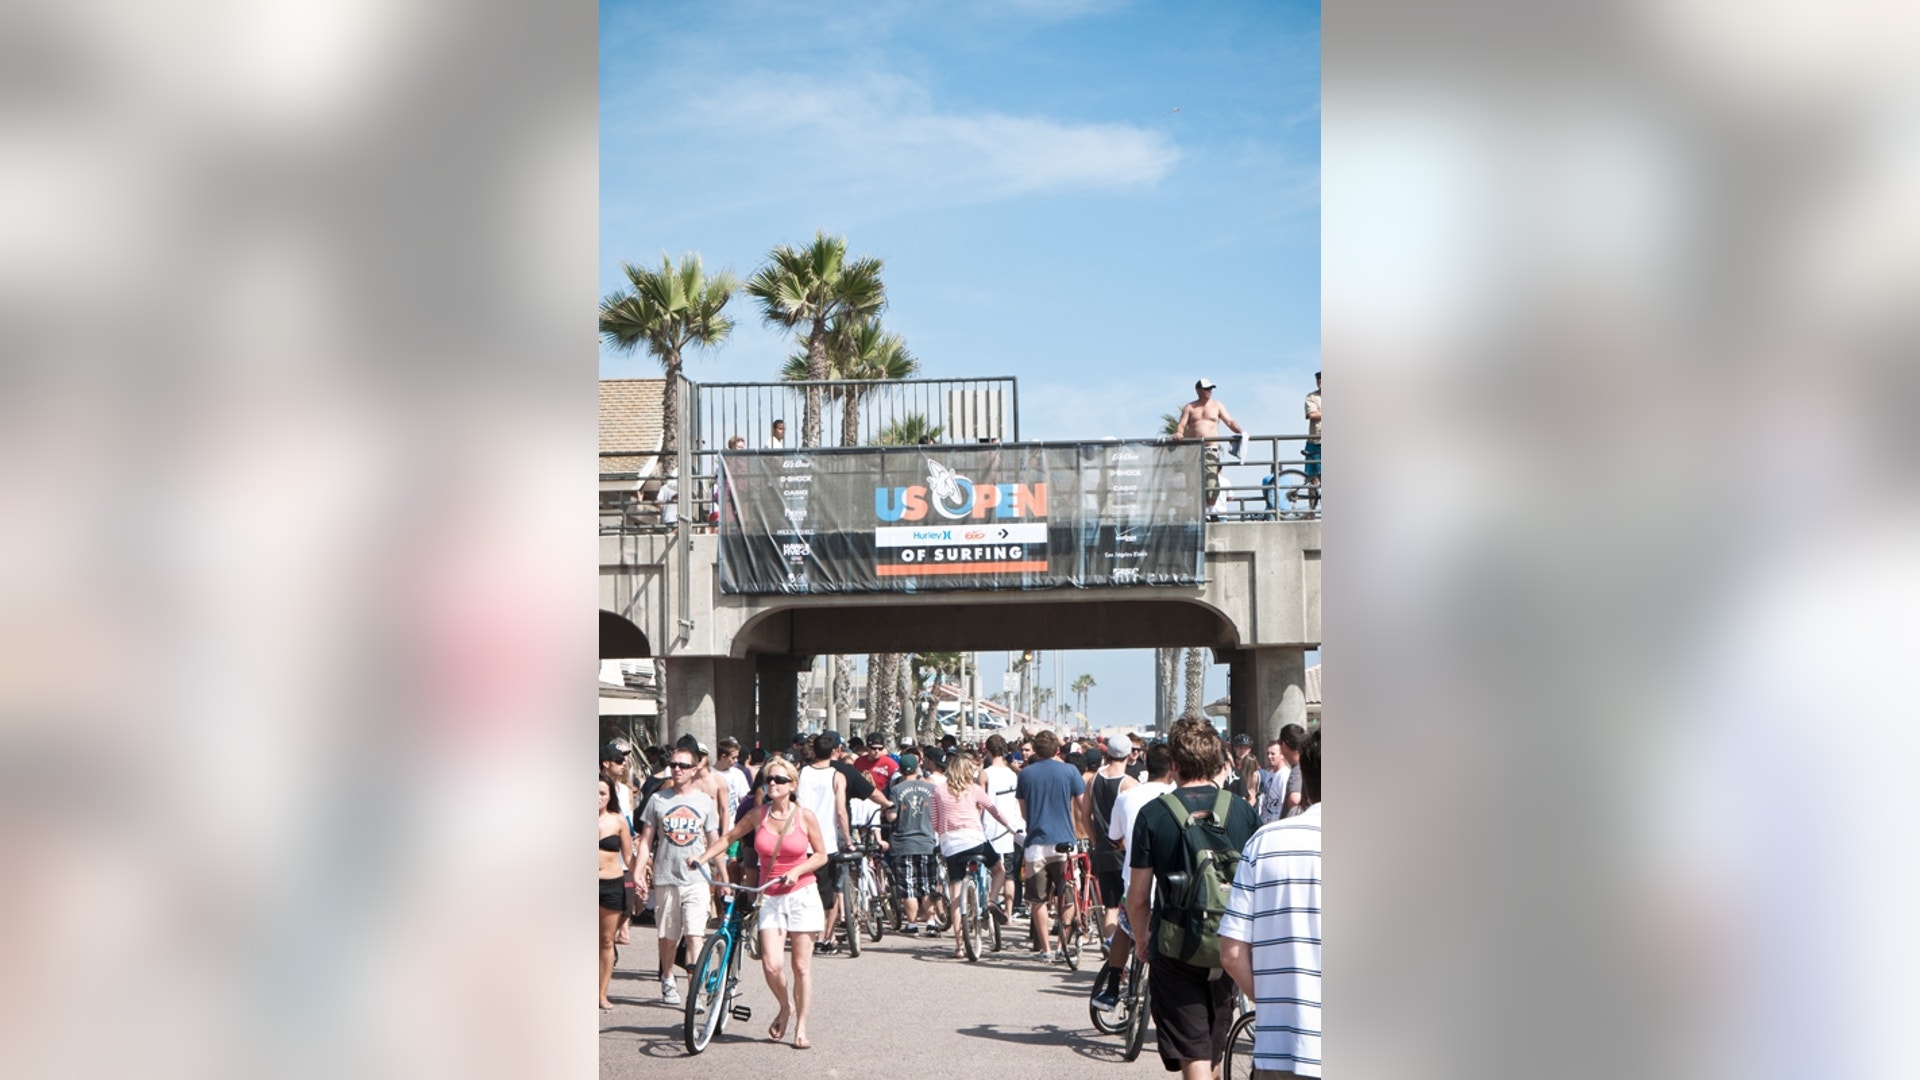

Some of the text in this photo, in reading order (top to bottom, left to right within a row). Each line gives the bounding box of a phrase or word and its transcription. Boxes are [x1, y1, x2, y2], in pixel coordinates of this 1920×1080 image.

[875, 475, 1047, 521] US OPEN
[913, 531, 942, 541] Hurley
[901, 546, 1022, 562] OF SURFING
